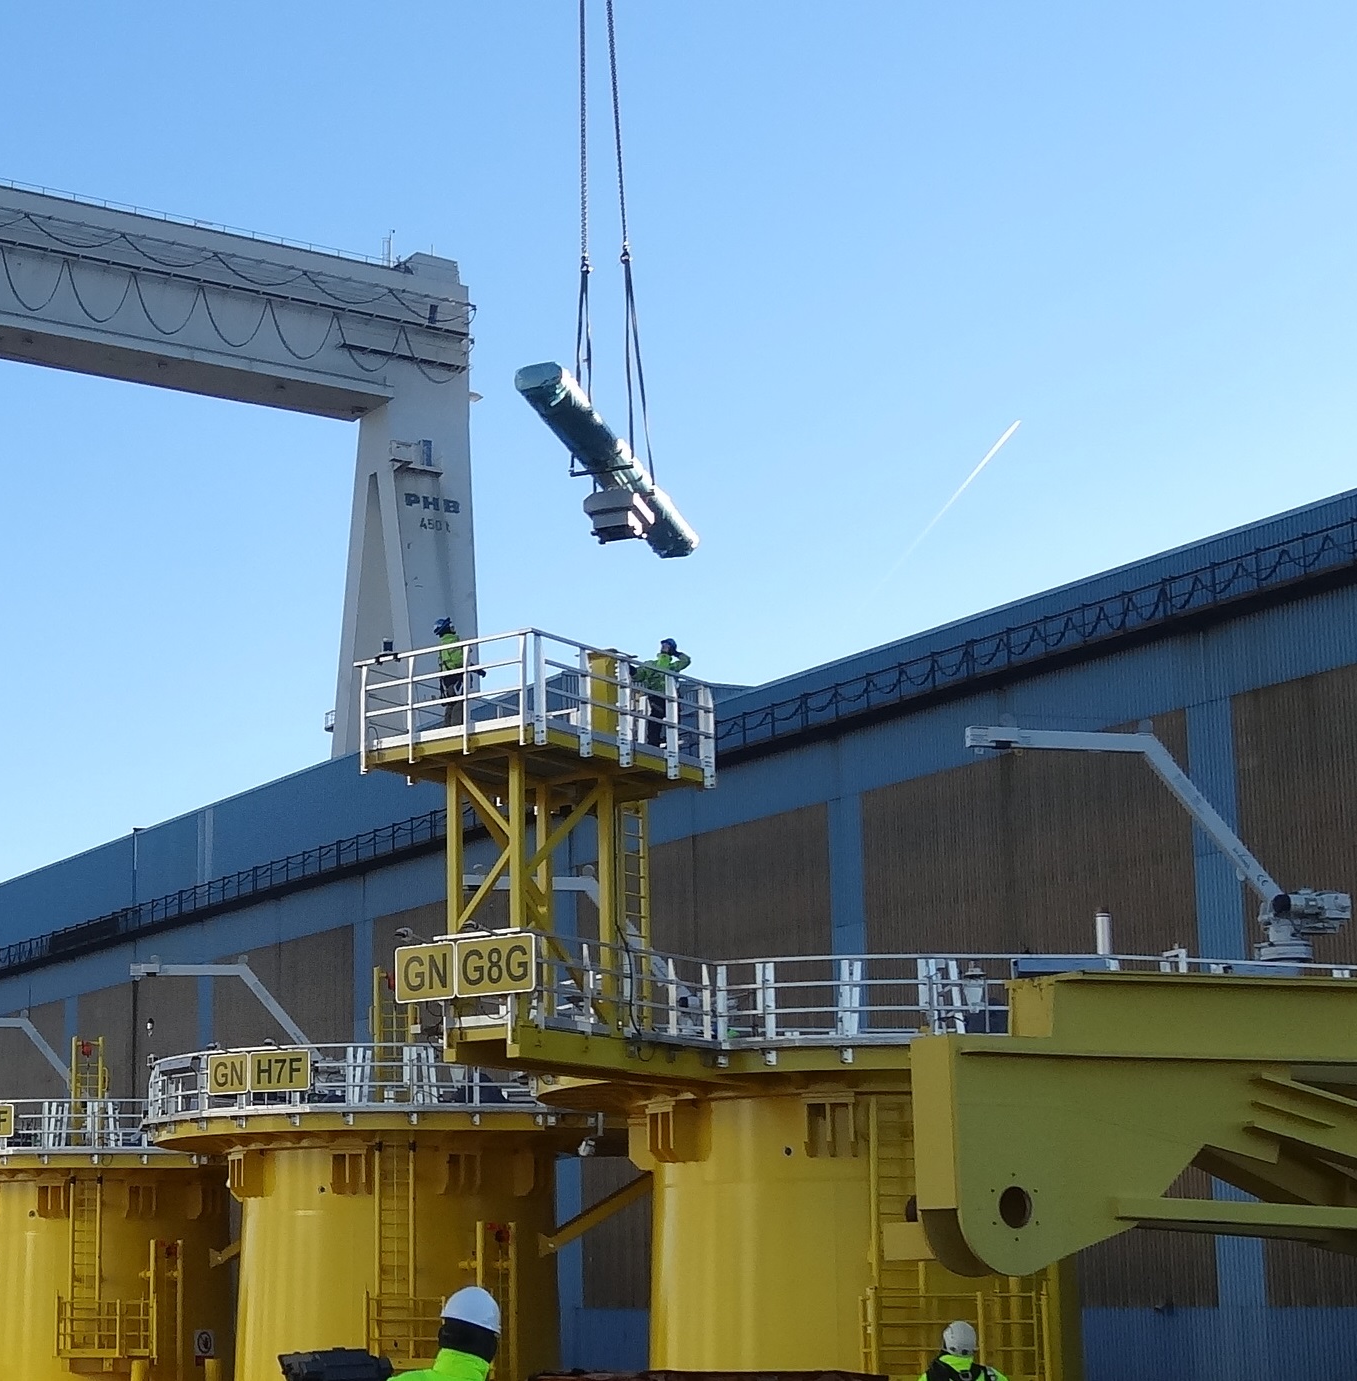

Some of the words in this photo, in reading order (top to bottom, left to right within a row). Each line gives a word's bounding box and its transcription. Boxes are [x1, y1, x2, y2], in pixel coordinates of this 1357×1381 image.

[404, 492, 461, 514] PHB
[419, 517, 442, 531] 450
[403, 956, 448, 991] GN
[461, 944, 529, 985] G8G
[213, 1058, 245, 1088] GN
[256, 1055, 303, 1085] H7F
